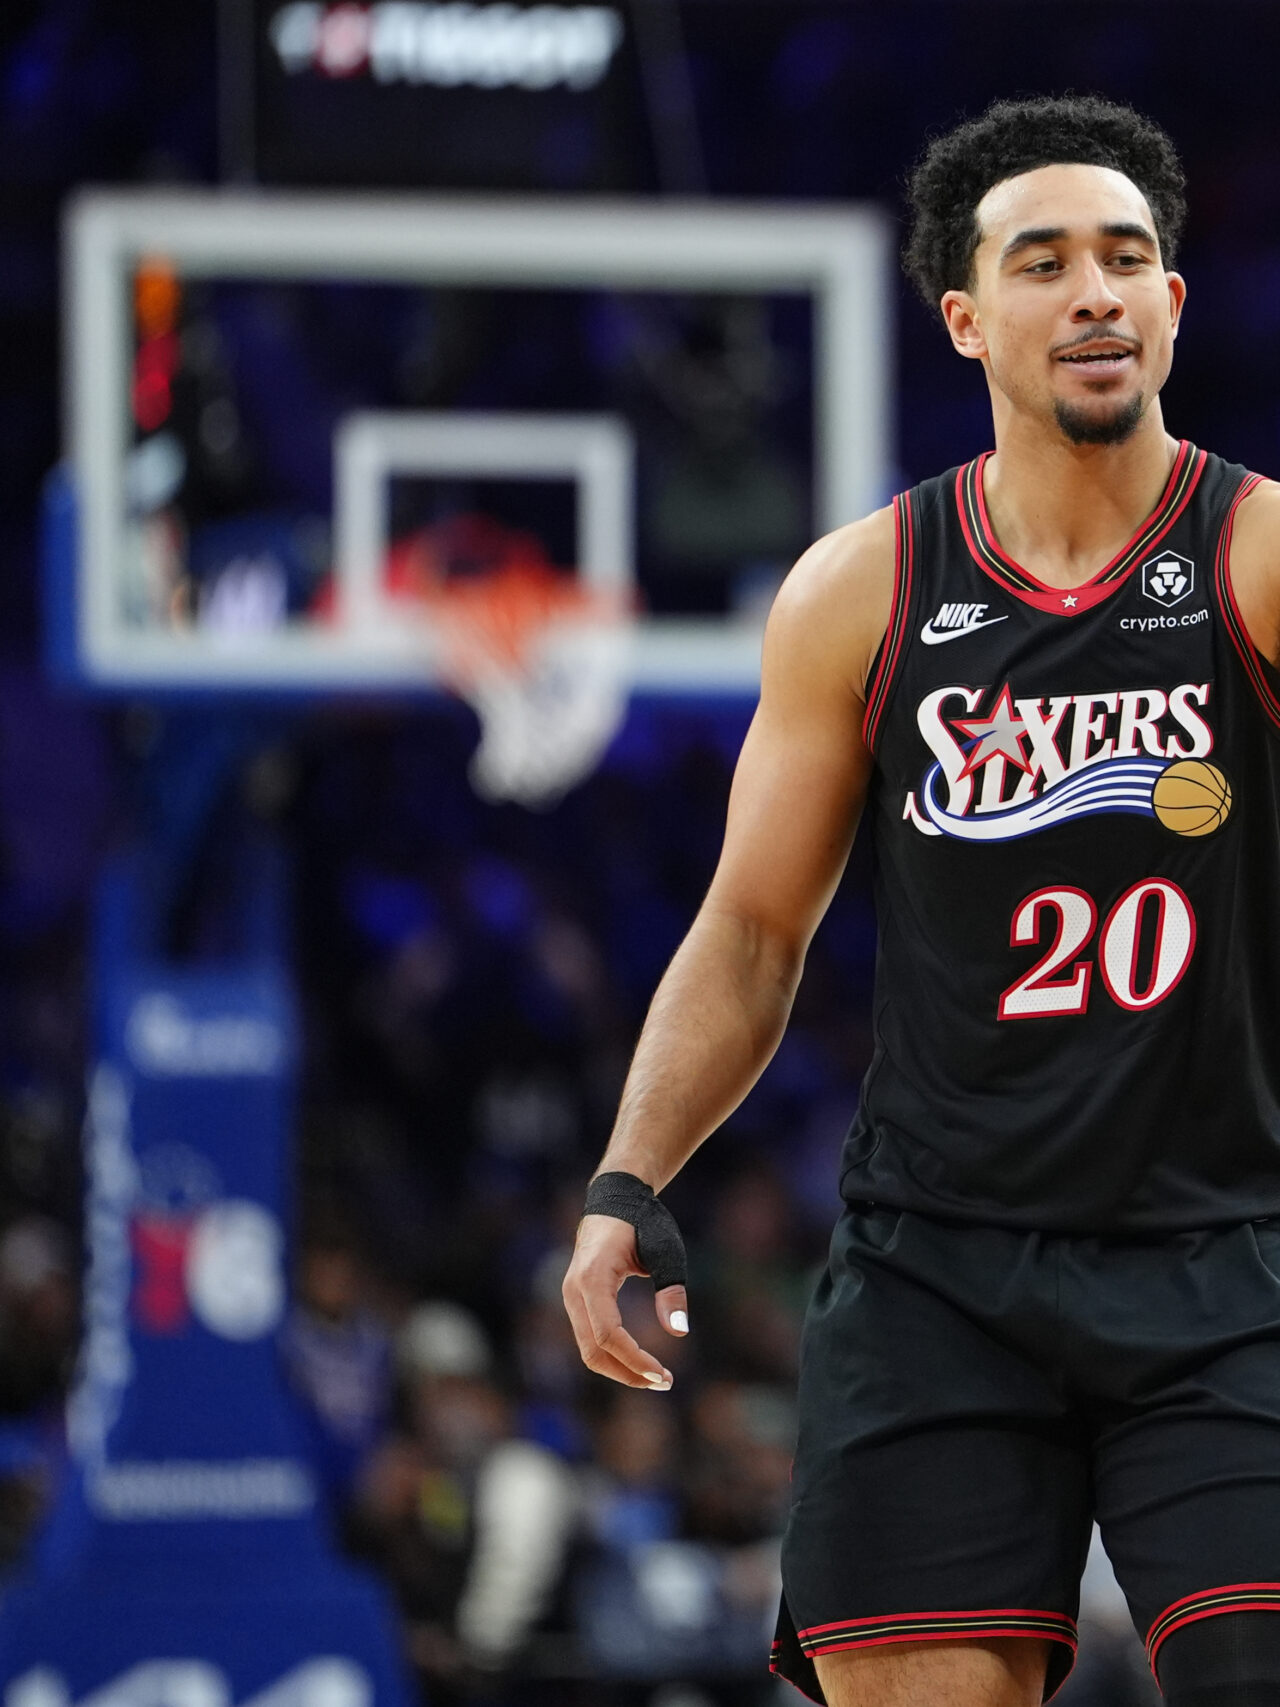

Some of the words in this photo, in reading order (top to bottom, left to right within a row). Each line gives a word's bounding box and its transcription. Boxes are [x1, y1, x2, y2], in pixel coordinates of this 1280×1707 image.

[931, 603, 989, 627] NIKE
[1120, 608, 1209, 631] crypto.com
[997, 876, 1197, 1021] 20
